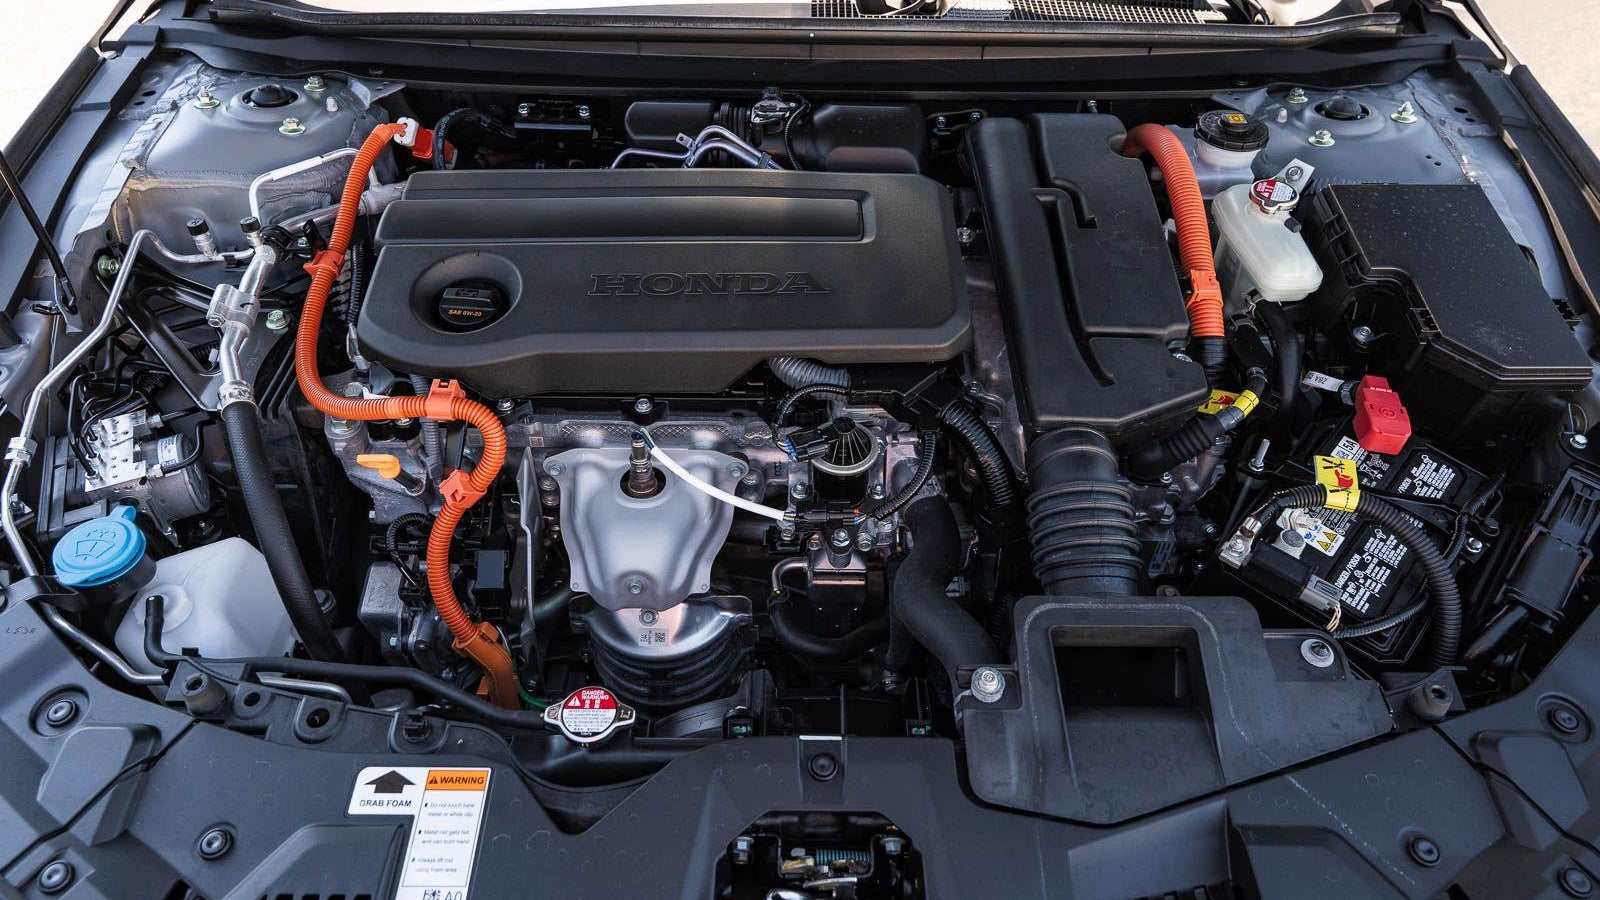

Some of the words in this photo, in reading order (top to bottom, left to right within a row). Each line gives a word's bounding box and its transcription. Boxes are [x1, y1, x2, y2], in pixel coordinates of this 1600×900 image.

[587, 271, 831, 296] HONDA
[440, 776, 484, 784] WARNING
[359, 799, 384, 807] GRAB
